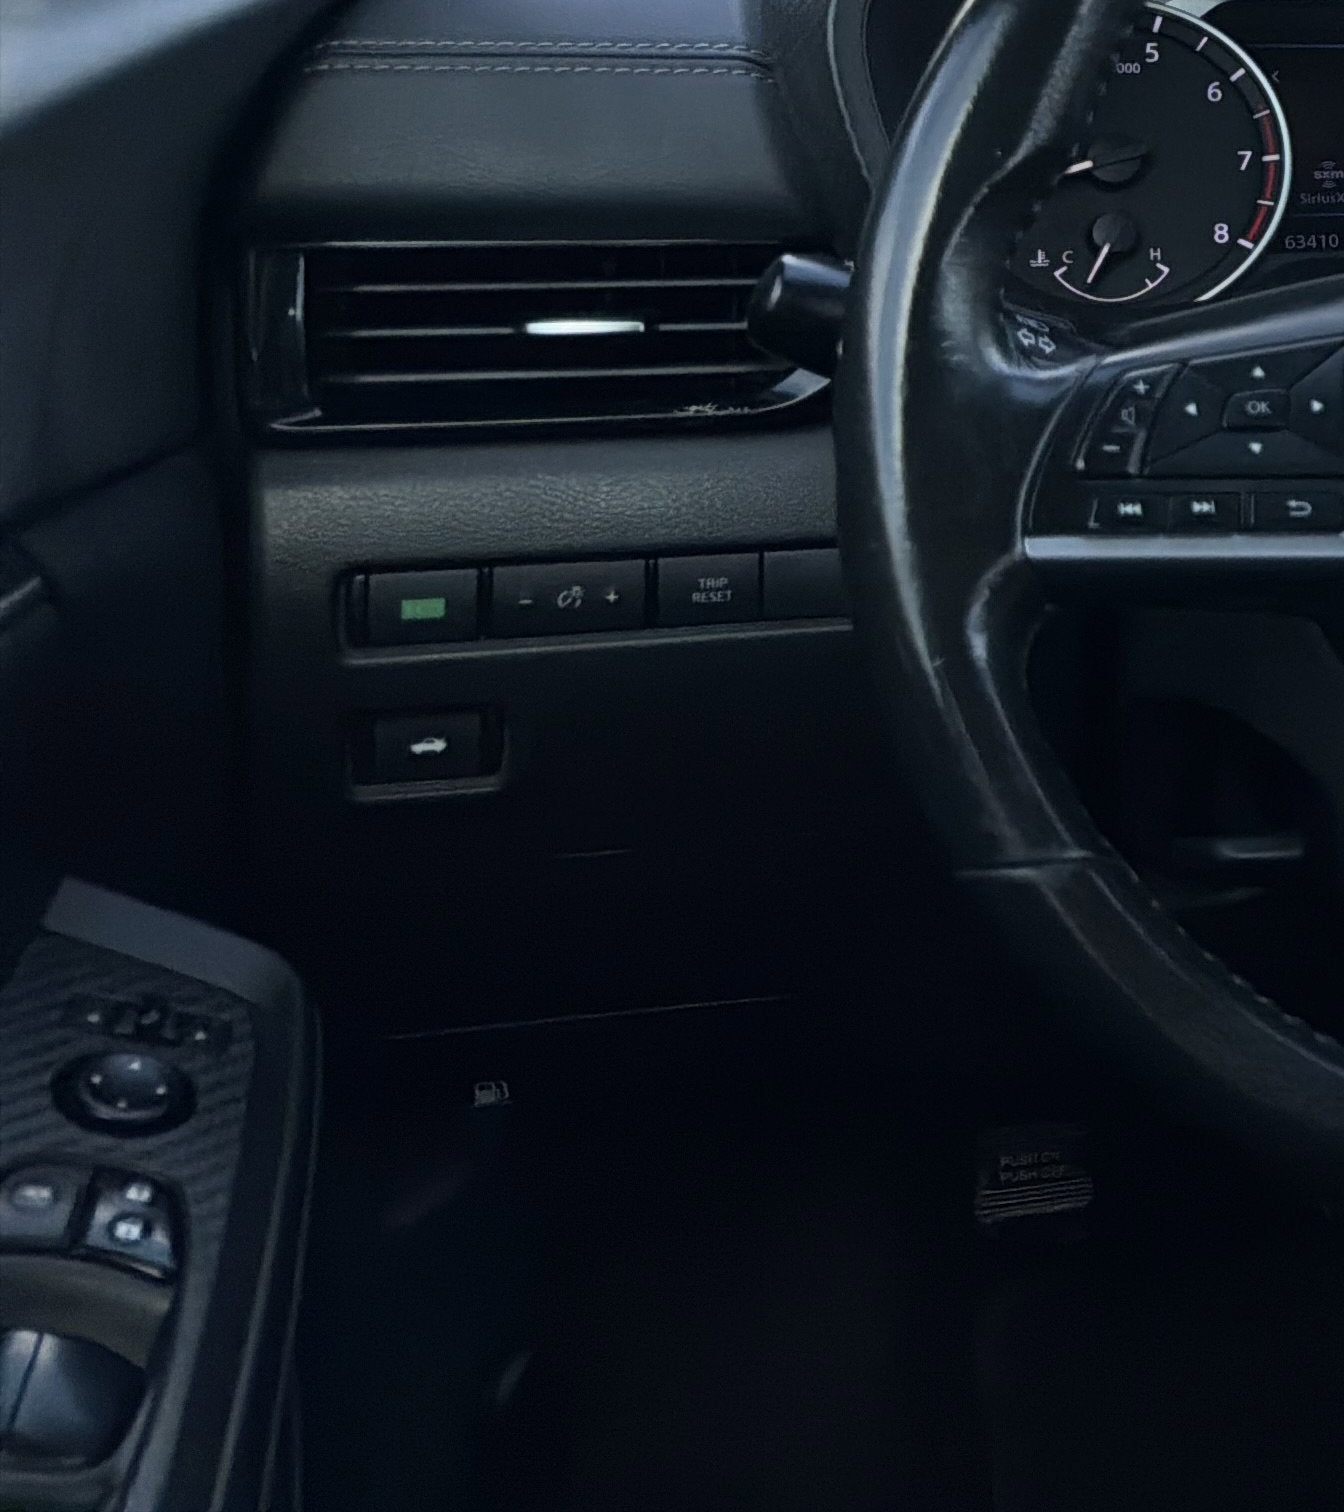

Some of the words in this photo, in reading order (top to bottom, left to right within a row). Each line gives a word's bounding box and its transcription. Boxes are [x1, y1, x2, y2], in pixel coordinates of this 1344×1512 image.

[1145, 42, 1159, 63] 5
[1207, 81, 1222, 102] 6
[1237, 150, 1252, 170] 7
[1213, 223, 1229, 244] 8
[1284, 234, 1340, 250] 63410
[1062, 250, 1074, 264] C
[1150, 248, 1162, 261] H
[1246, 399, 1271, 414] OK
[692, 589, 732, 604] RESET
